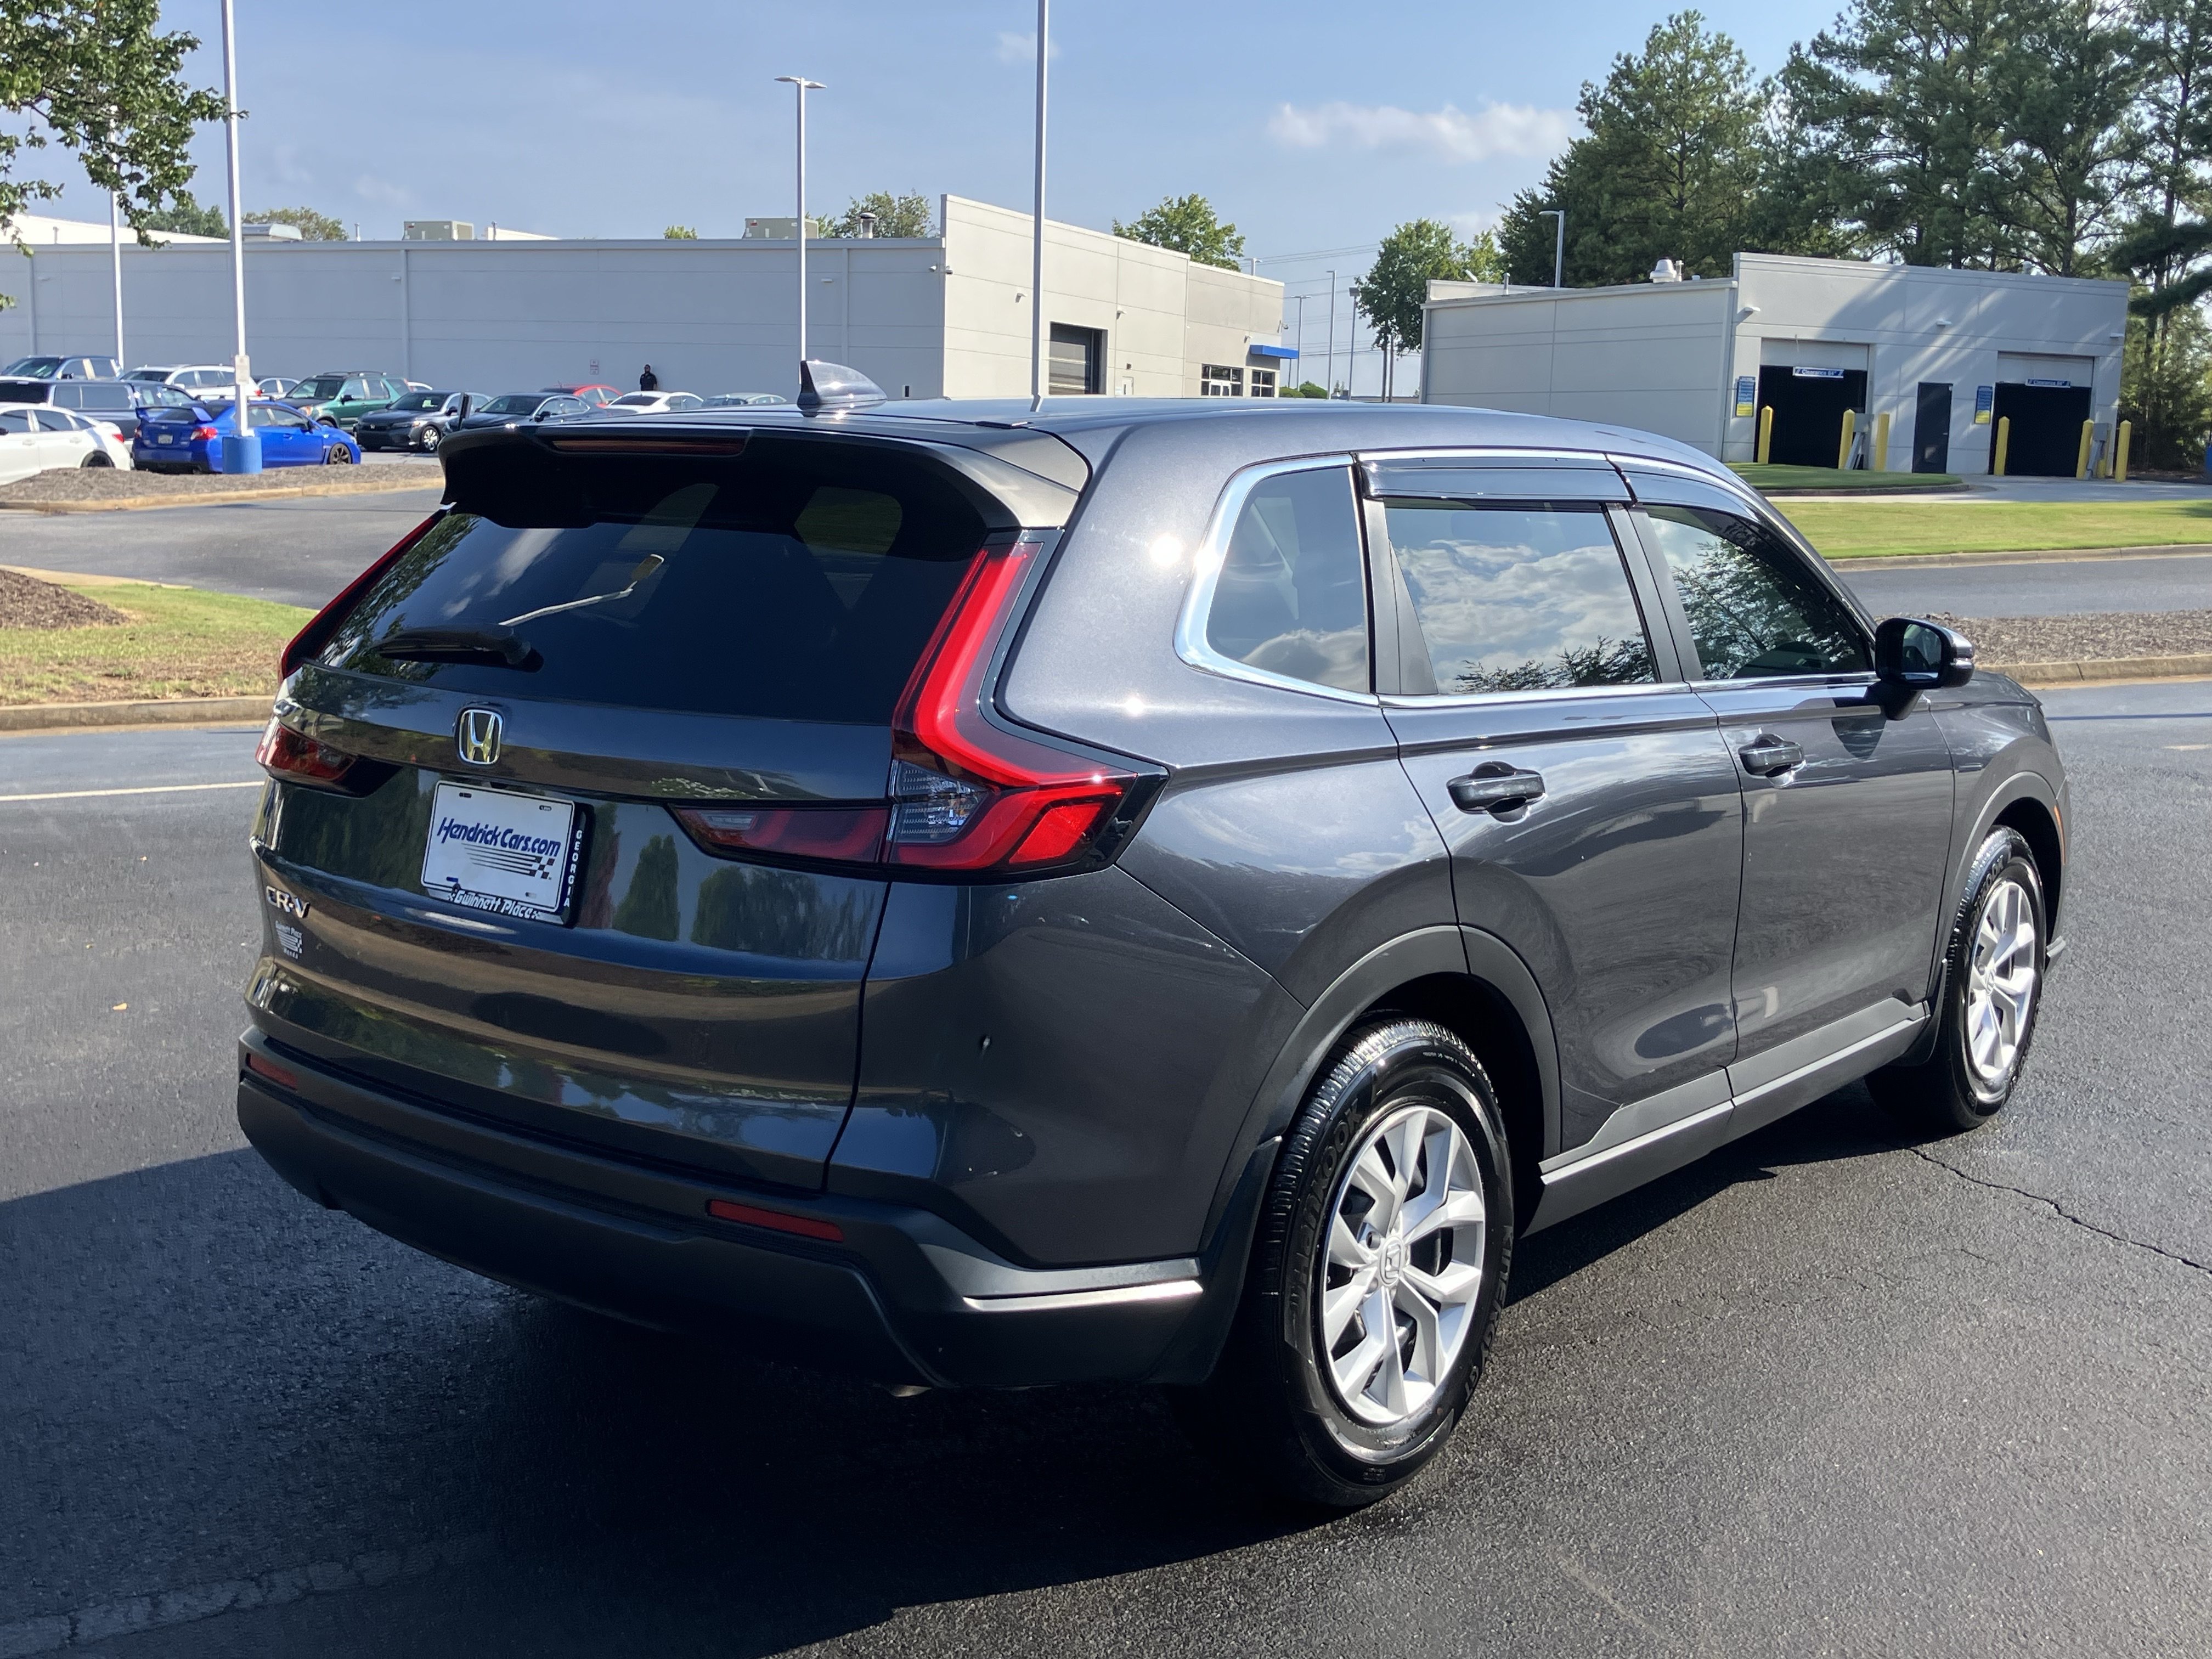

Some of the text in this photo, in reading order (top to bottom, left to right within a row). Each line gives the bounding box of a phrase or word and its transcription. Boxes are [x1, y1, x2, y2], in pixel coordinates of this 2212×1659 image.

[563, 830, 583, 907] GEORGIA
[454, 890, 535, 919] Gwinnett Place
